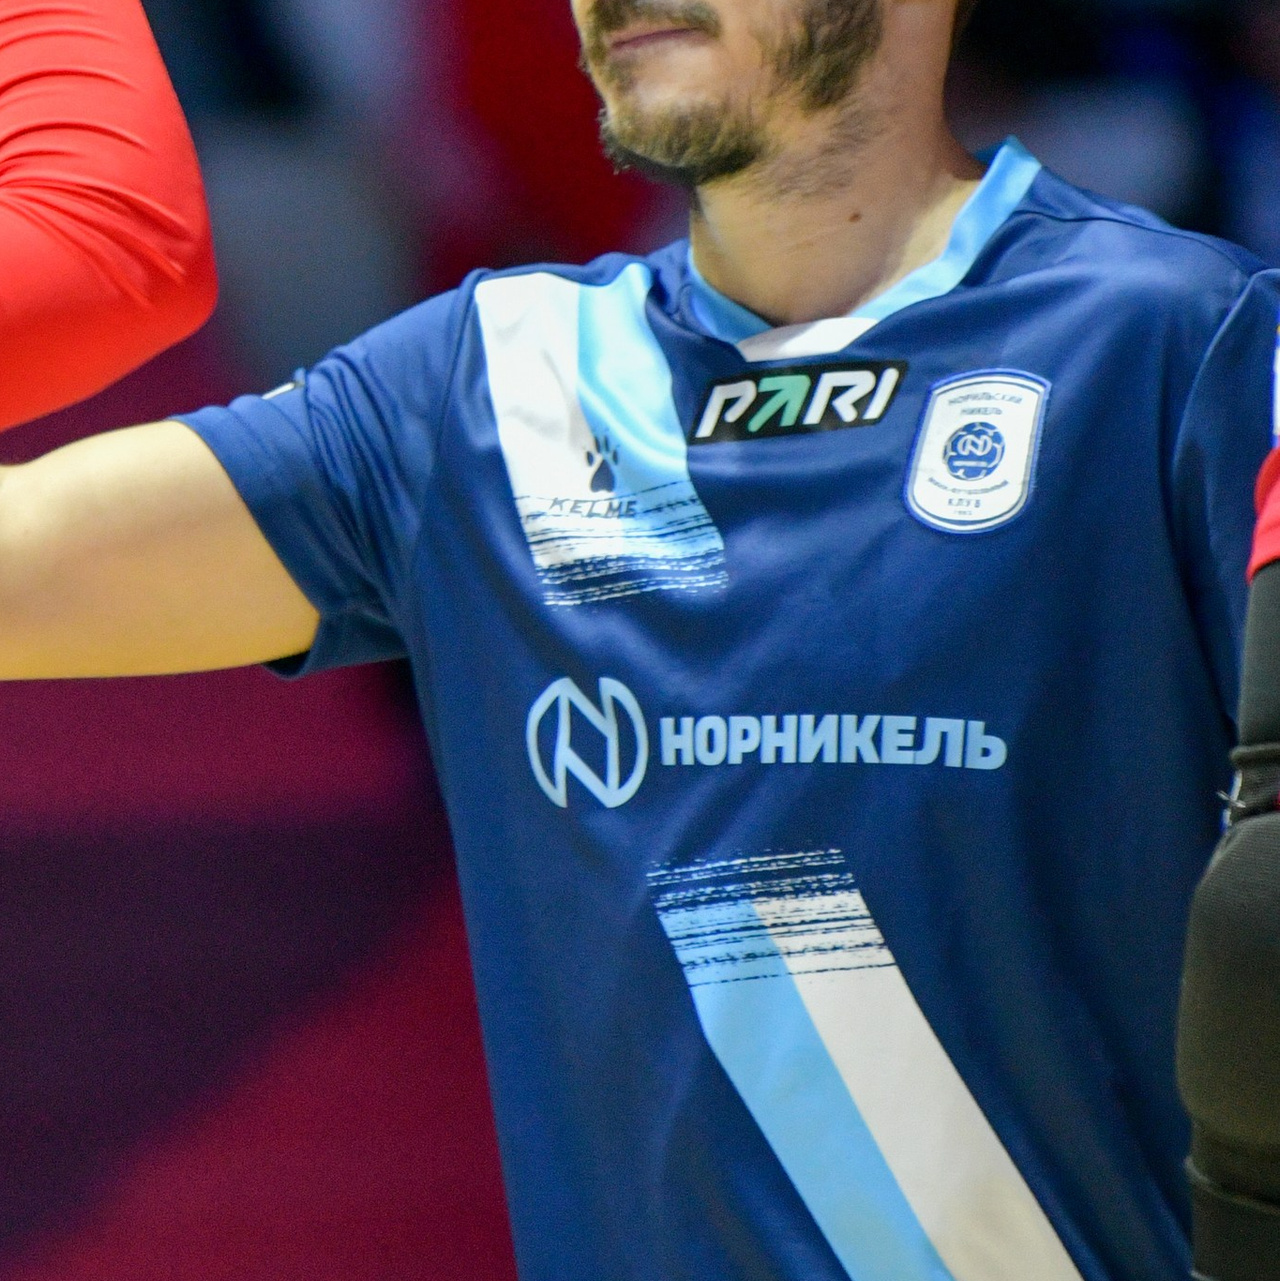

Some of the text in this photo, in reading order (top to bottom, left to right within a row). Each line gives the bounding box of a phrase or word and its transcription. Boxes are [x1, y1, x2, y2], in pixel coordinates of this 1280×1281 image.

[695, 367, 900, 439] PARI
[549, 497, 638, 519] KELME
[660, 713, 1009, 770] НОРНИКЕЛЬ
